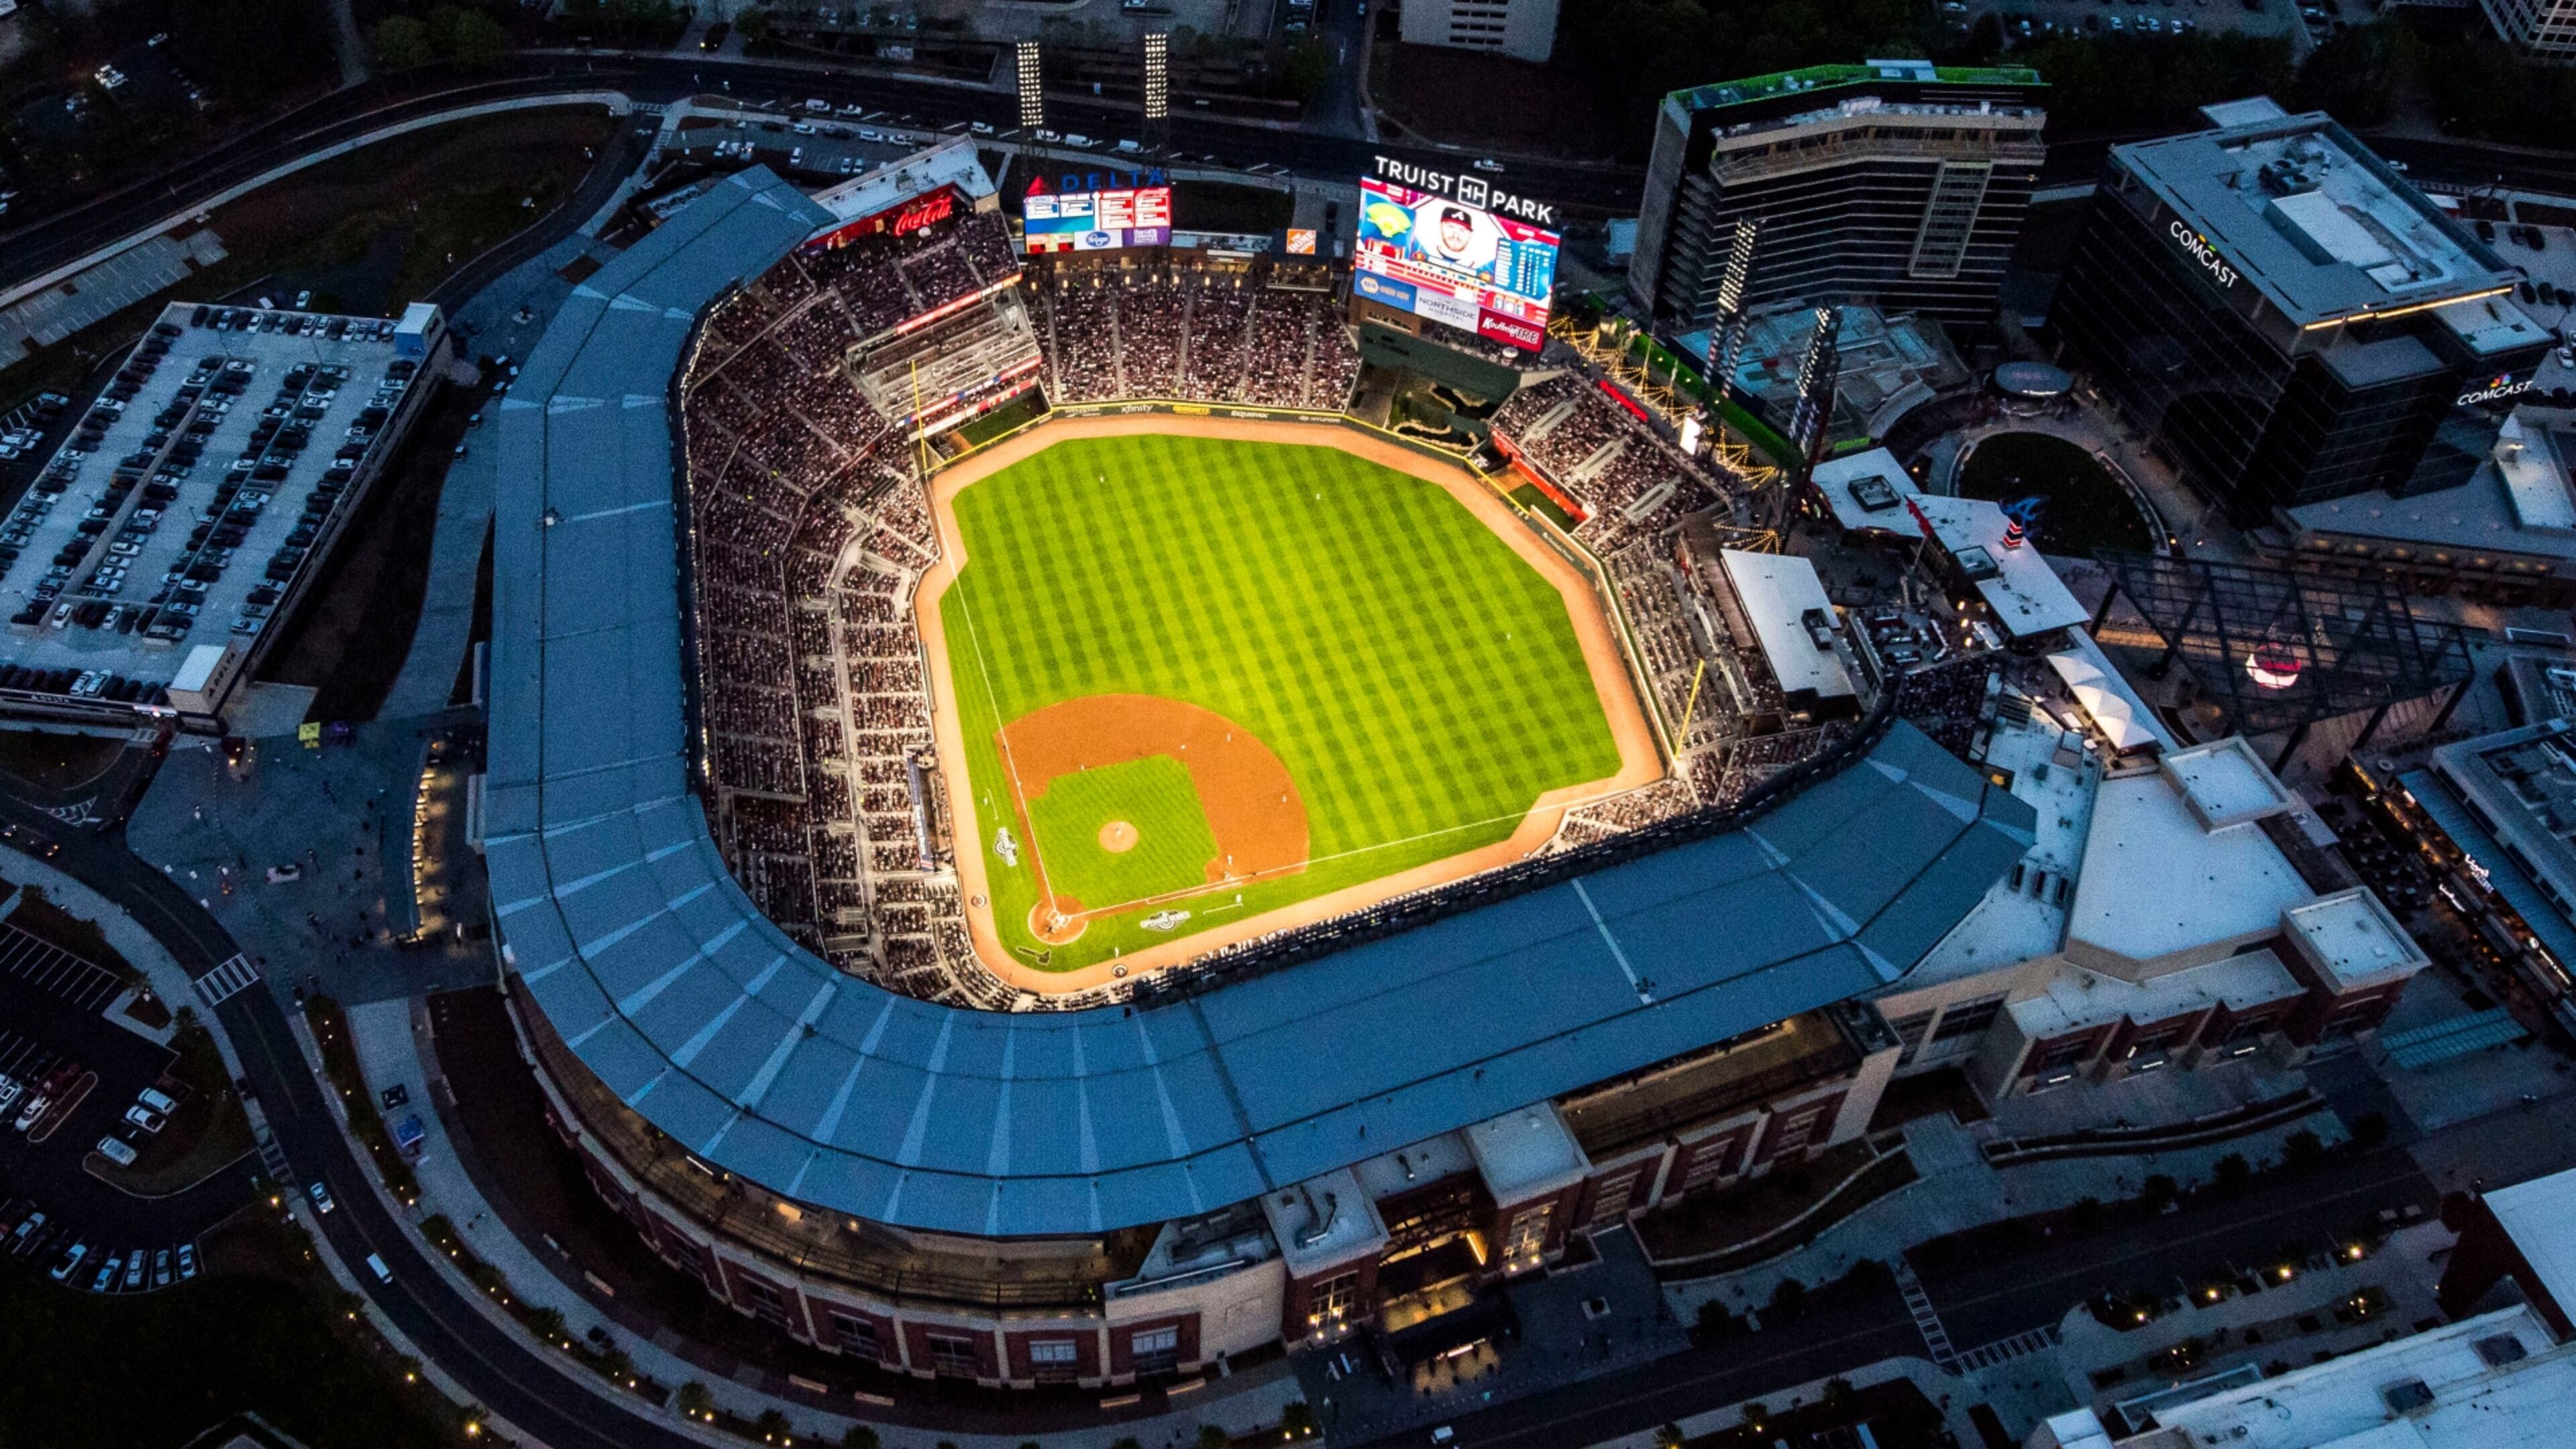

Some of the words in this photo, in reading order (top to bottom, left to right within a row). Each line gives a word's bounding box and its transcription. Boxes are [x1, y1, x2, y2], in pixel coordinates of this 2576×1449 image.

[1061, 168, 1165, 192] DELTA
[1375, 155, 1454, 193] TRUIST
[1492, 191, 1553, 225] PARK
[895, 195, 953, 237] Coca-Cola
[1087, 232, 1110, 246] Kroger
[2170, 221, 2239, 288] COMCAST
[1419, 297, 1477, 321] NORTHSIDE
[2457, 380, 2534, 406] COMCAST
[1121, 404, 1153, 414] xfinity
